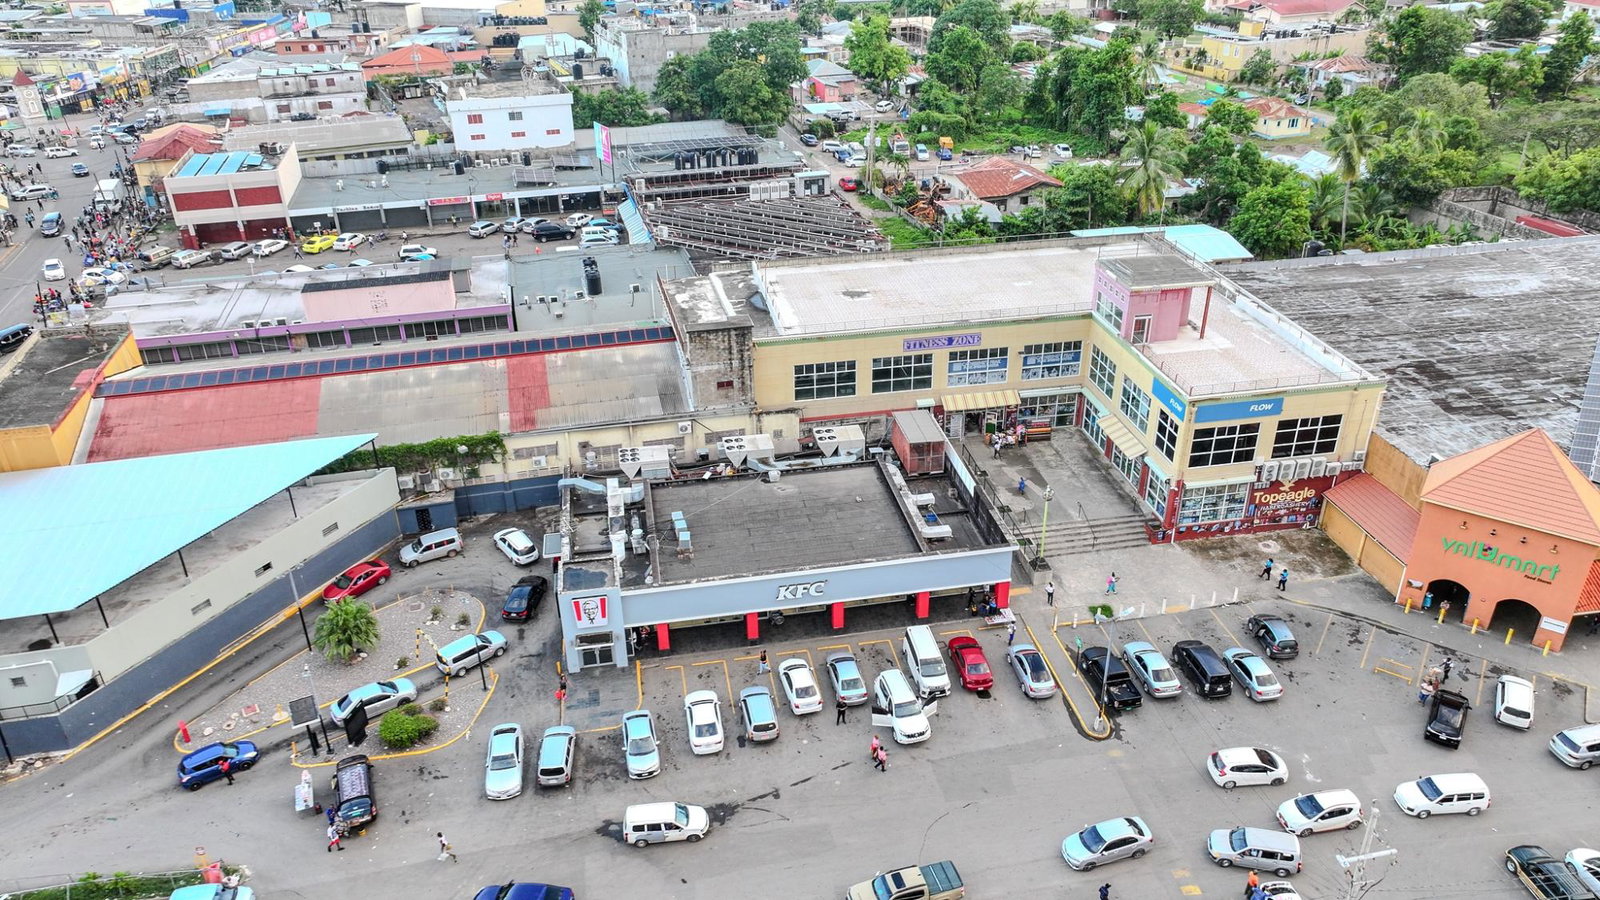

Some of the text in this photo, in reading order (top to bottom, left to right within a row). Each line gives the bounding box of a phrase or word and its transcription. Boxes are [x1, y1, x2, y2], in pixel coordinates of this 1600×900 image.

[904, 333, 981, 351] FITNESS ZONE
[1169, 398, 1183, 413] FLOW
[1249, 403, 1274, 412] FLOW
[1253, 486, 1316, 505] Topeagle
[776, 580, 825, 601] KFC
